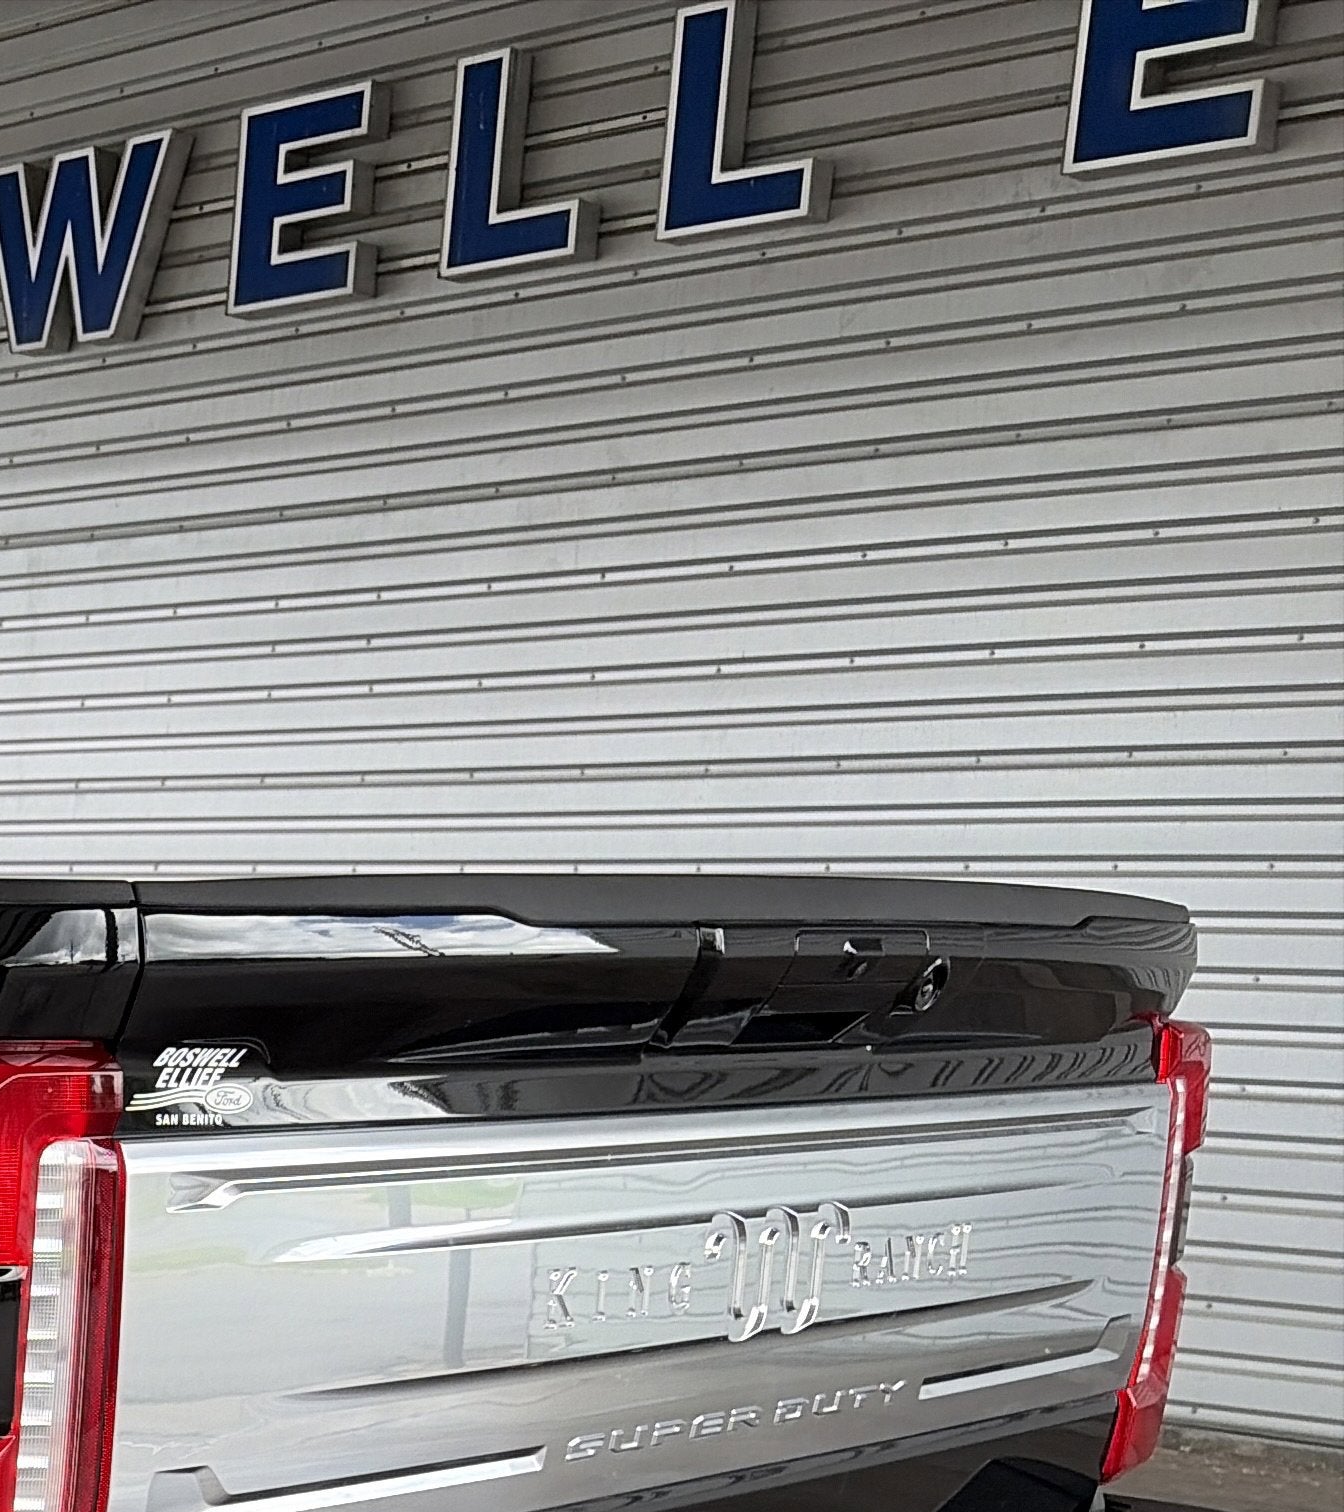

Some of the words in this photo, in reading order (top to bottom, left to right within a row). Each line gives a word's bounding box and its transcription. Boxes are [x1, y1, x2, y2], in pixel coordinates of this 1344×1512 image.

[153, 1046, 248, 1067] BOSWELL
[155, 1067, 226, 1088] ELLIFF
[214, 1089, 242, 1108] Ford
[155, 1113, 179, 1126] SAN
[182, 1113, 223, 1126] BENITO
[543, 1261, 692, 1331] KING
[851, 1221, 974, 1289] RANCH
[564, 1403, 763, 1462] SUPER
[773, 1378, 907, 1424] DUTY
